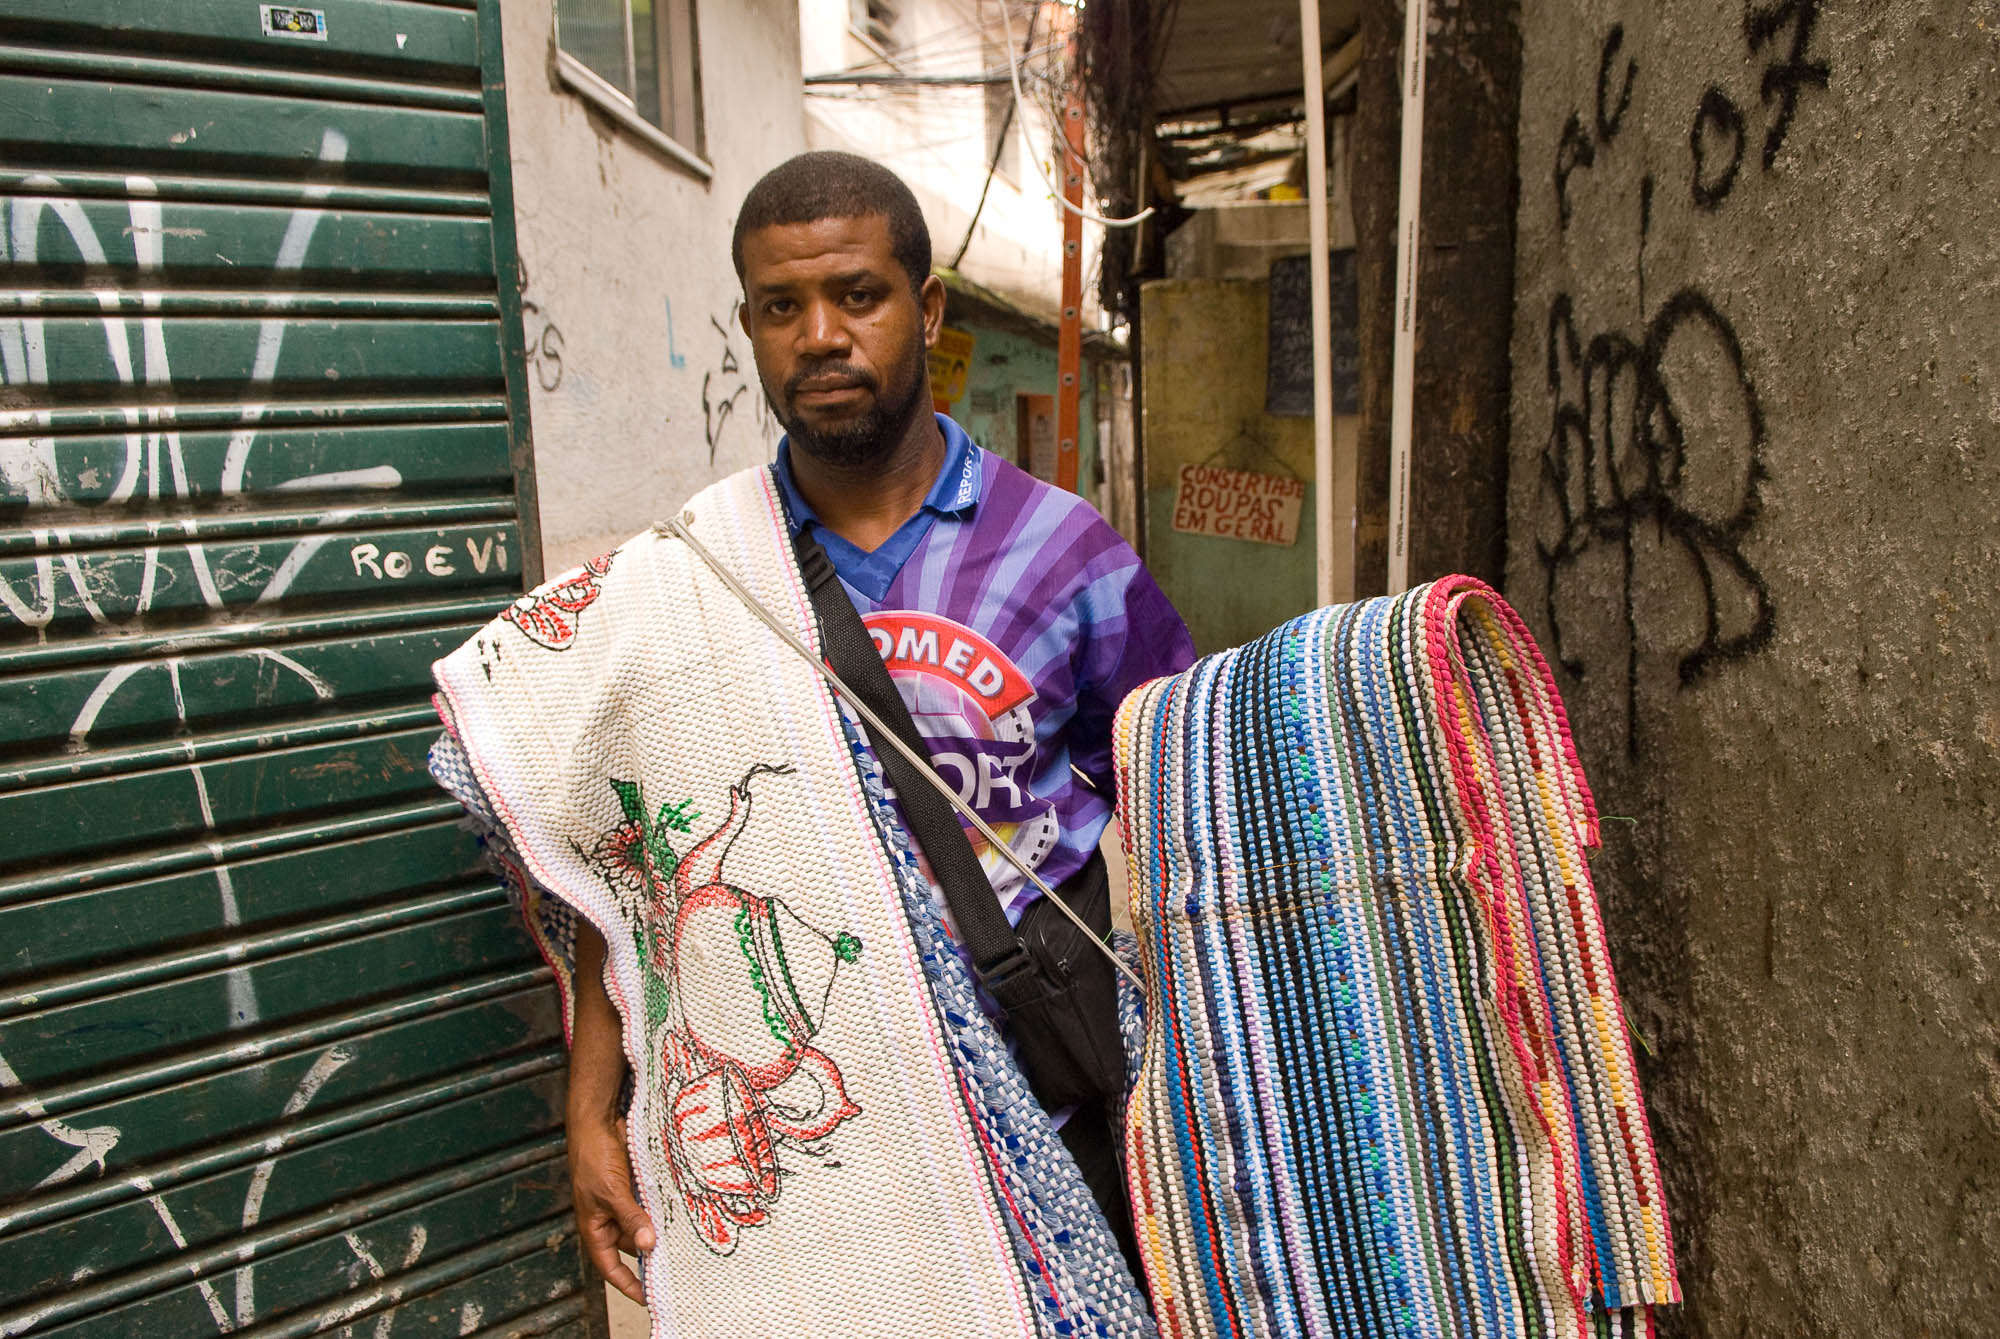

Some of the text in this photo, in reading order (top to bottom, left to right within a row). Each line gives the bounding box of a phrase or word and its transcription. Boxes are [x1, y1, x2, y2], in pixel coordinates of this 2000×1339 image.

[1179, 483, 1284, 521] ROUPAS
[1175, 508, 1287, 543] EM GERAL
